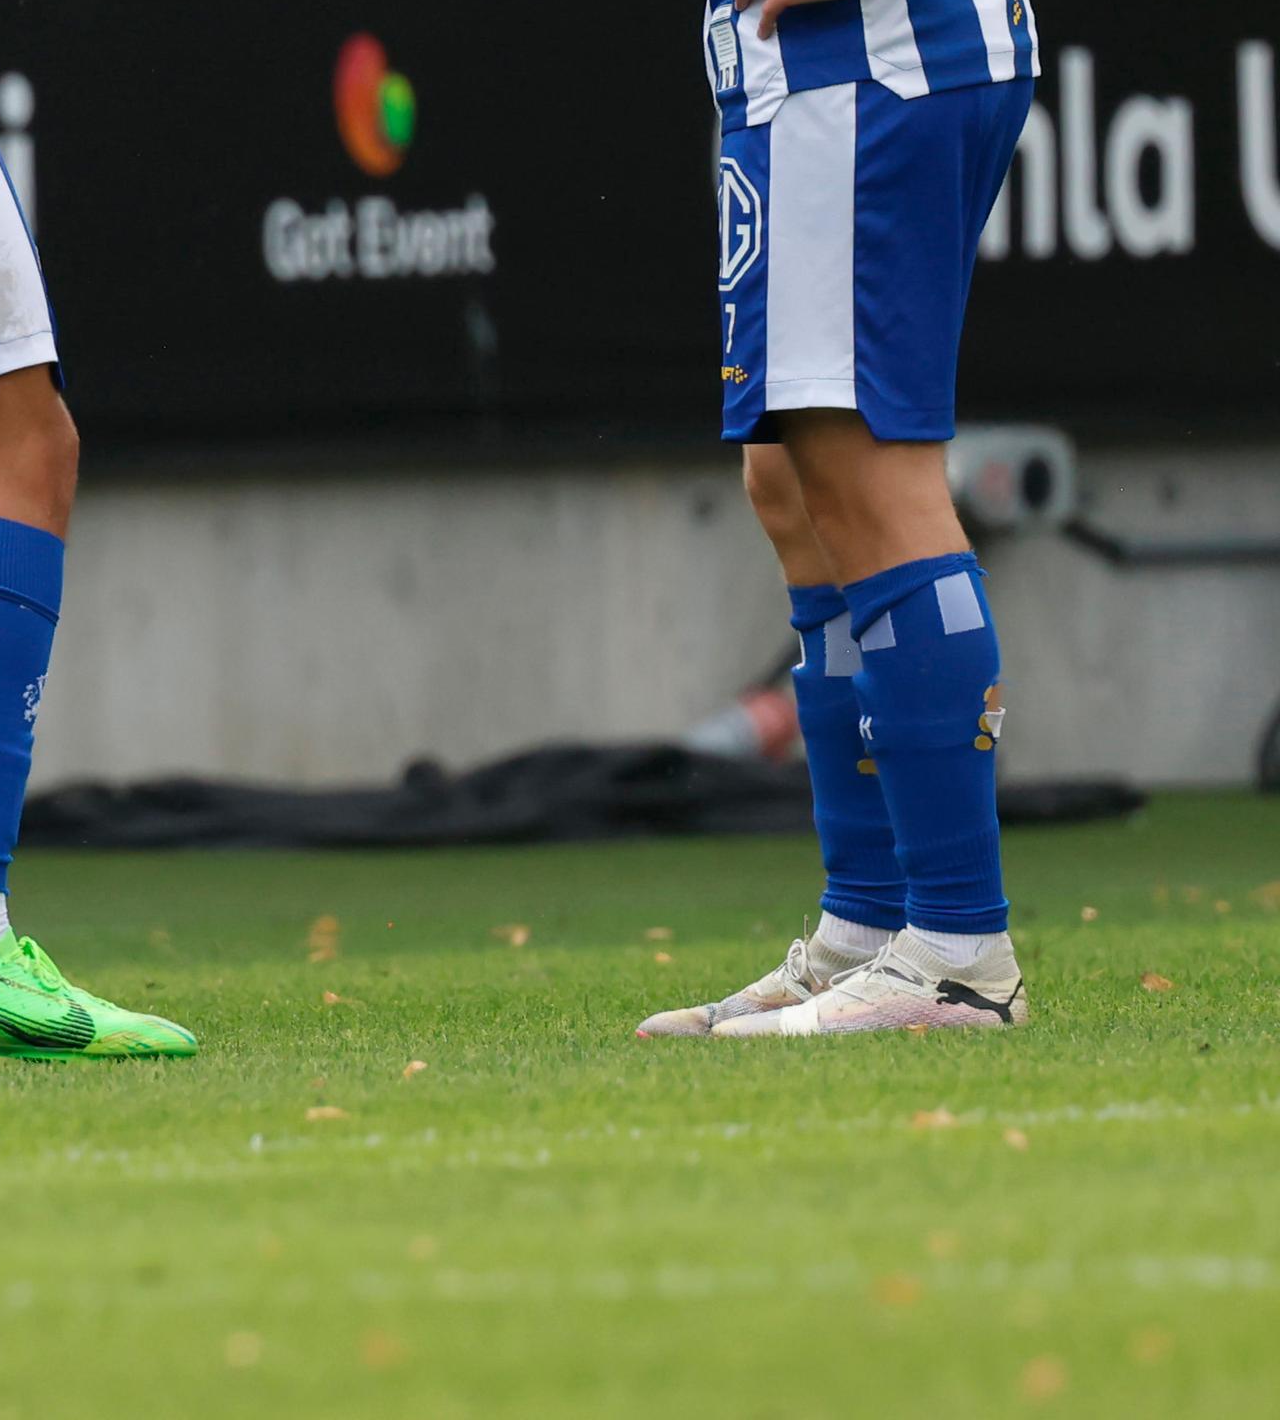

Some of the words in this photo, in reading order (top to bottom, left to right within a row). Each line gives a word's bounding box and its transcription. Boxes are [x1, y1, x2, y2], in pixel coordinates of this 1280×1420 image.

[262, 195, 353, 281] Got
[355, 191, 497, 279] Event
[724, 302, 737, 354] 7
